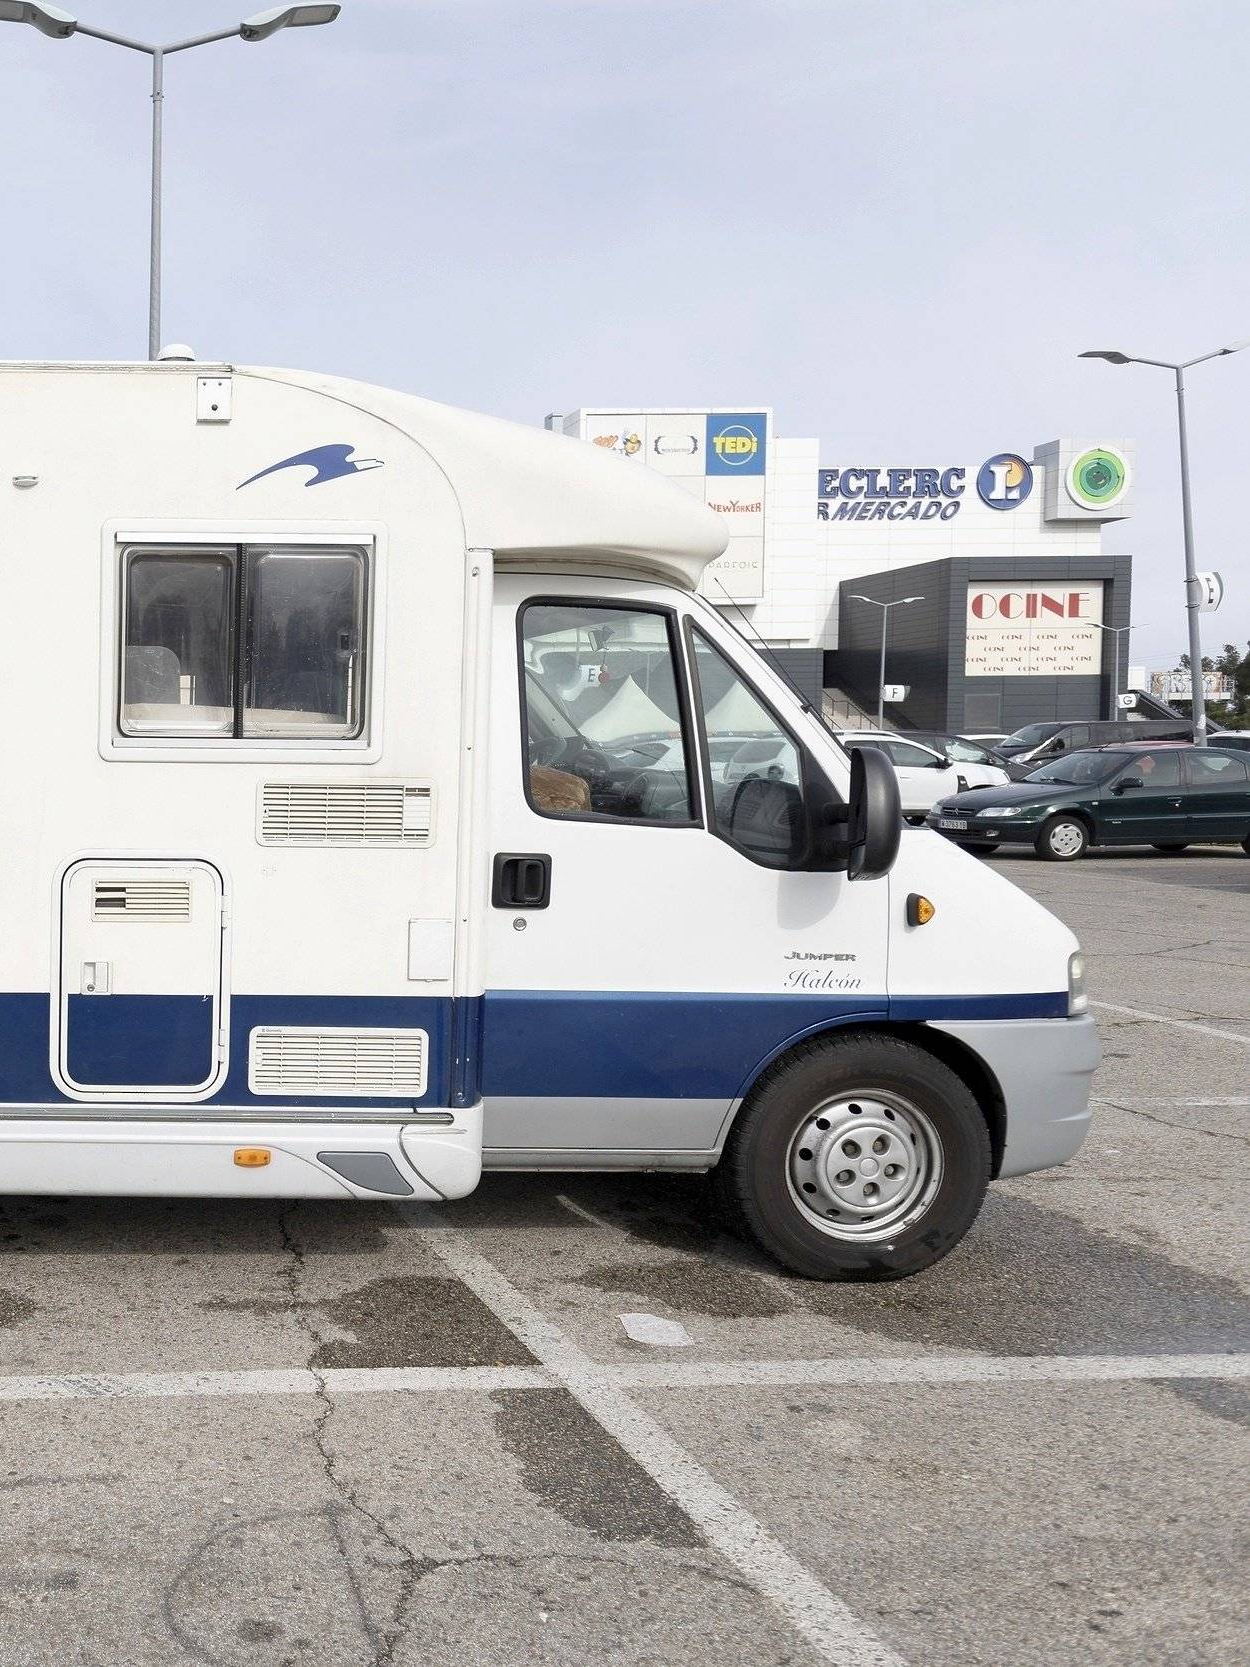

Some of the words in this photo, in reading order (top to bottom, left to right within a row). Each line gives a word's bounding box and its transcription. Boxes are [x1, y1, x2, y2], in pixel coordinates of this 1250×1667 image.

[713, 436, 757, 454] TEDi
[831, 501, 961, 521] MERCADO
[971, 592, 1091, 619] OCINE
[892, 687, 898, 699] F
[1123, 695, 1132, 705] G
[784, 951, 857, 962] JUMPER
